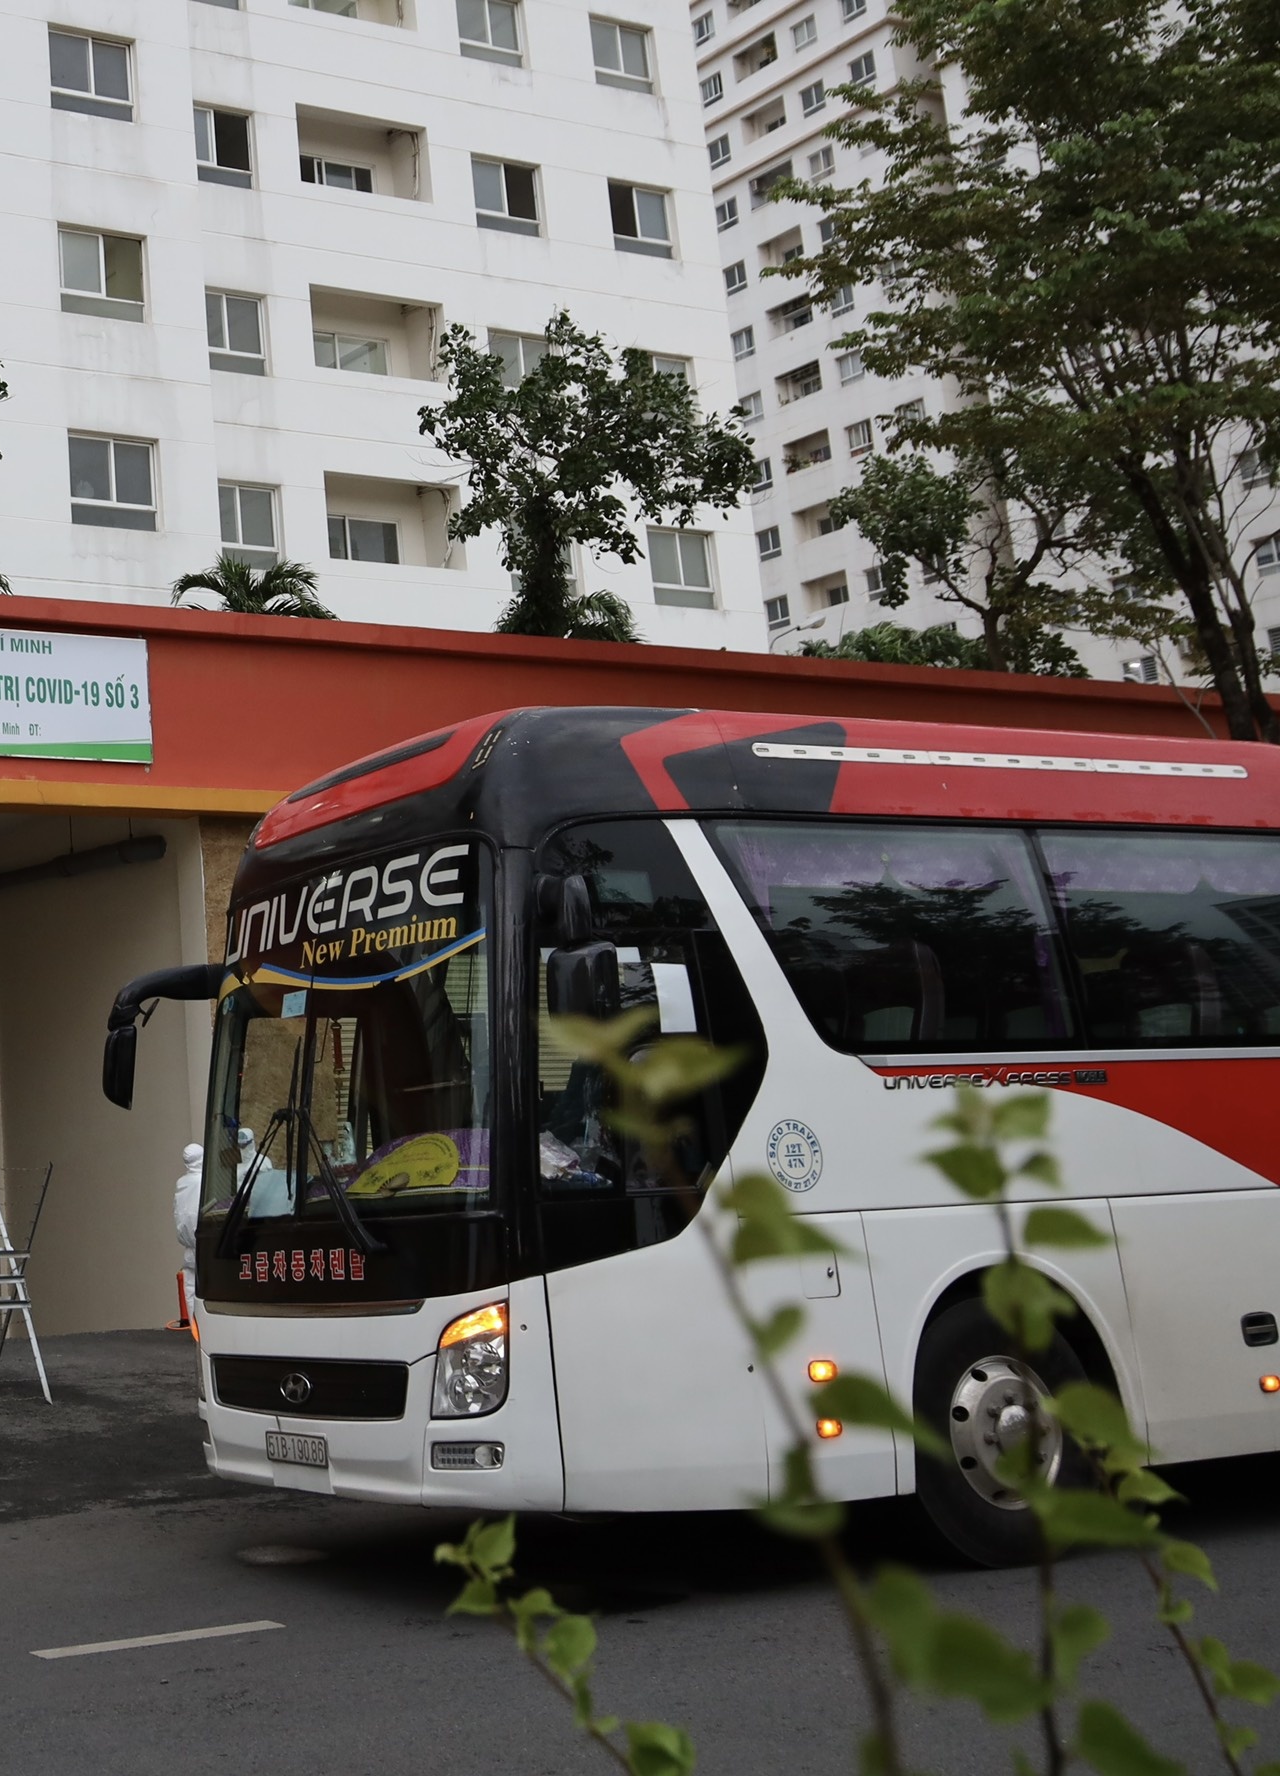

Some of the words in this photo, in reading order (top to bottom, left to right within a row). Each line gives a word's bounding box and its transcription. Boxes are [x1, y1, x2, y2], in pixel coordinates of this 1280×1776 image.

[10, 637, 53, 655] MINH
[25, 676, 99, 707] COVID-19
[105, 674, 125, 709] SỐ
[130, 683, 139, 709] 3
[2, 722, 20, 735] Minh
[29, 723, 42, 737] ĐT:
[224, 844, 470, 967] UNIVERSE
[300, 938, 346, 970] New
[348, 914, 457, 959] Premium
[769, 1127, 784, 1159] SACO
[785, 1122, 820, 1157] TRAVEL
[785, 1143, 803, 1154] 12T
[787, 1158, 805, 1169] 47N
[776, 1171, 793, 1188] 0918
